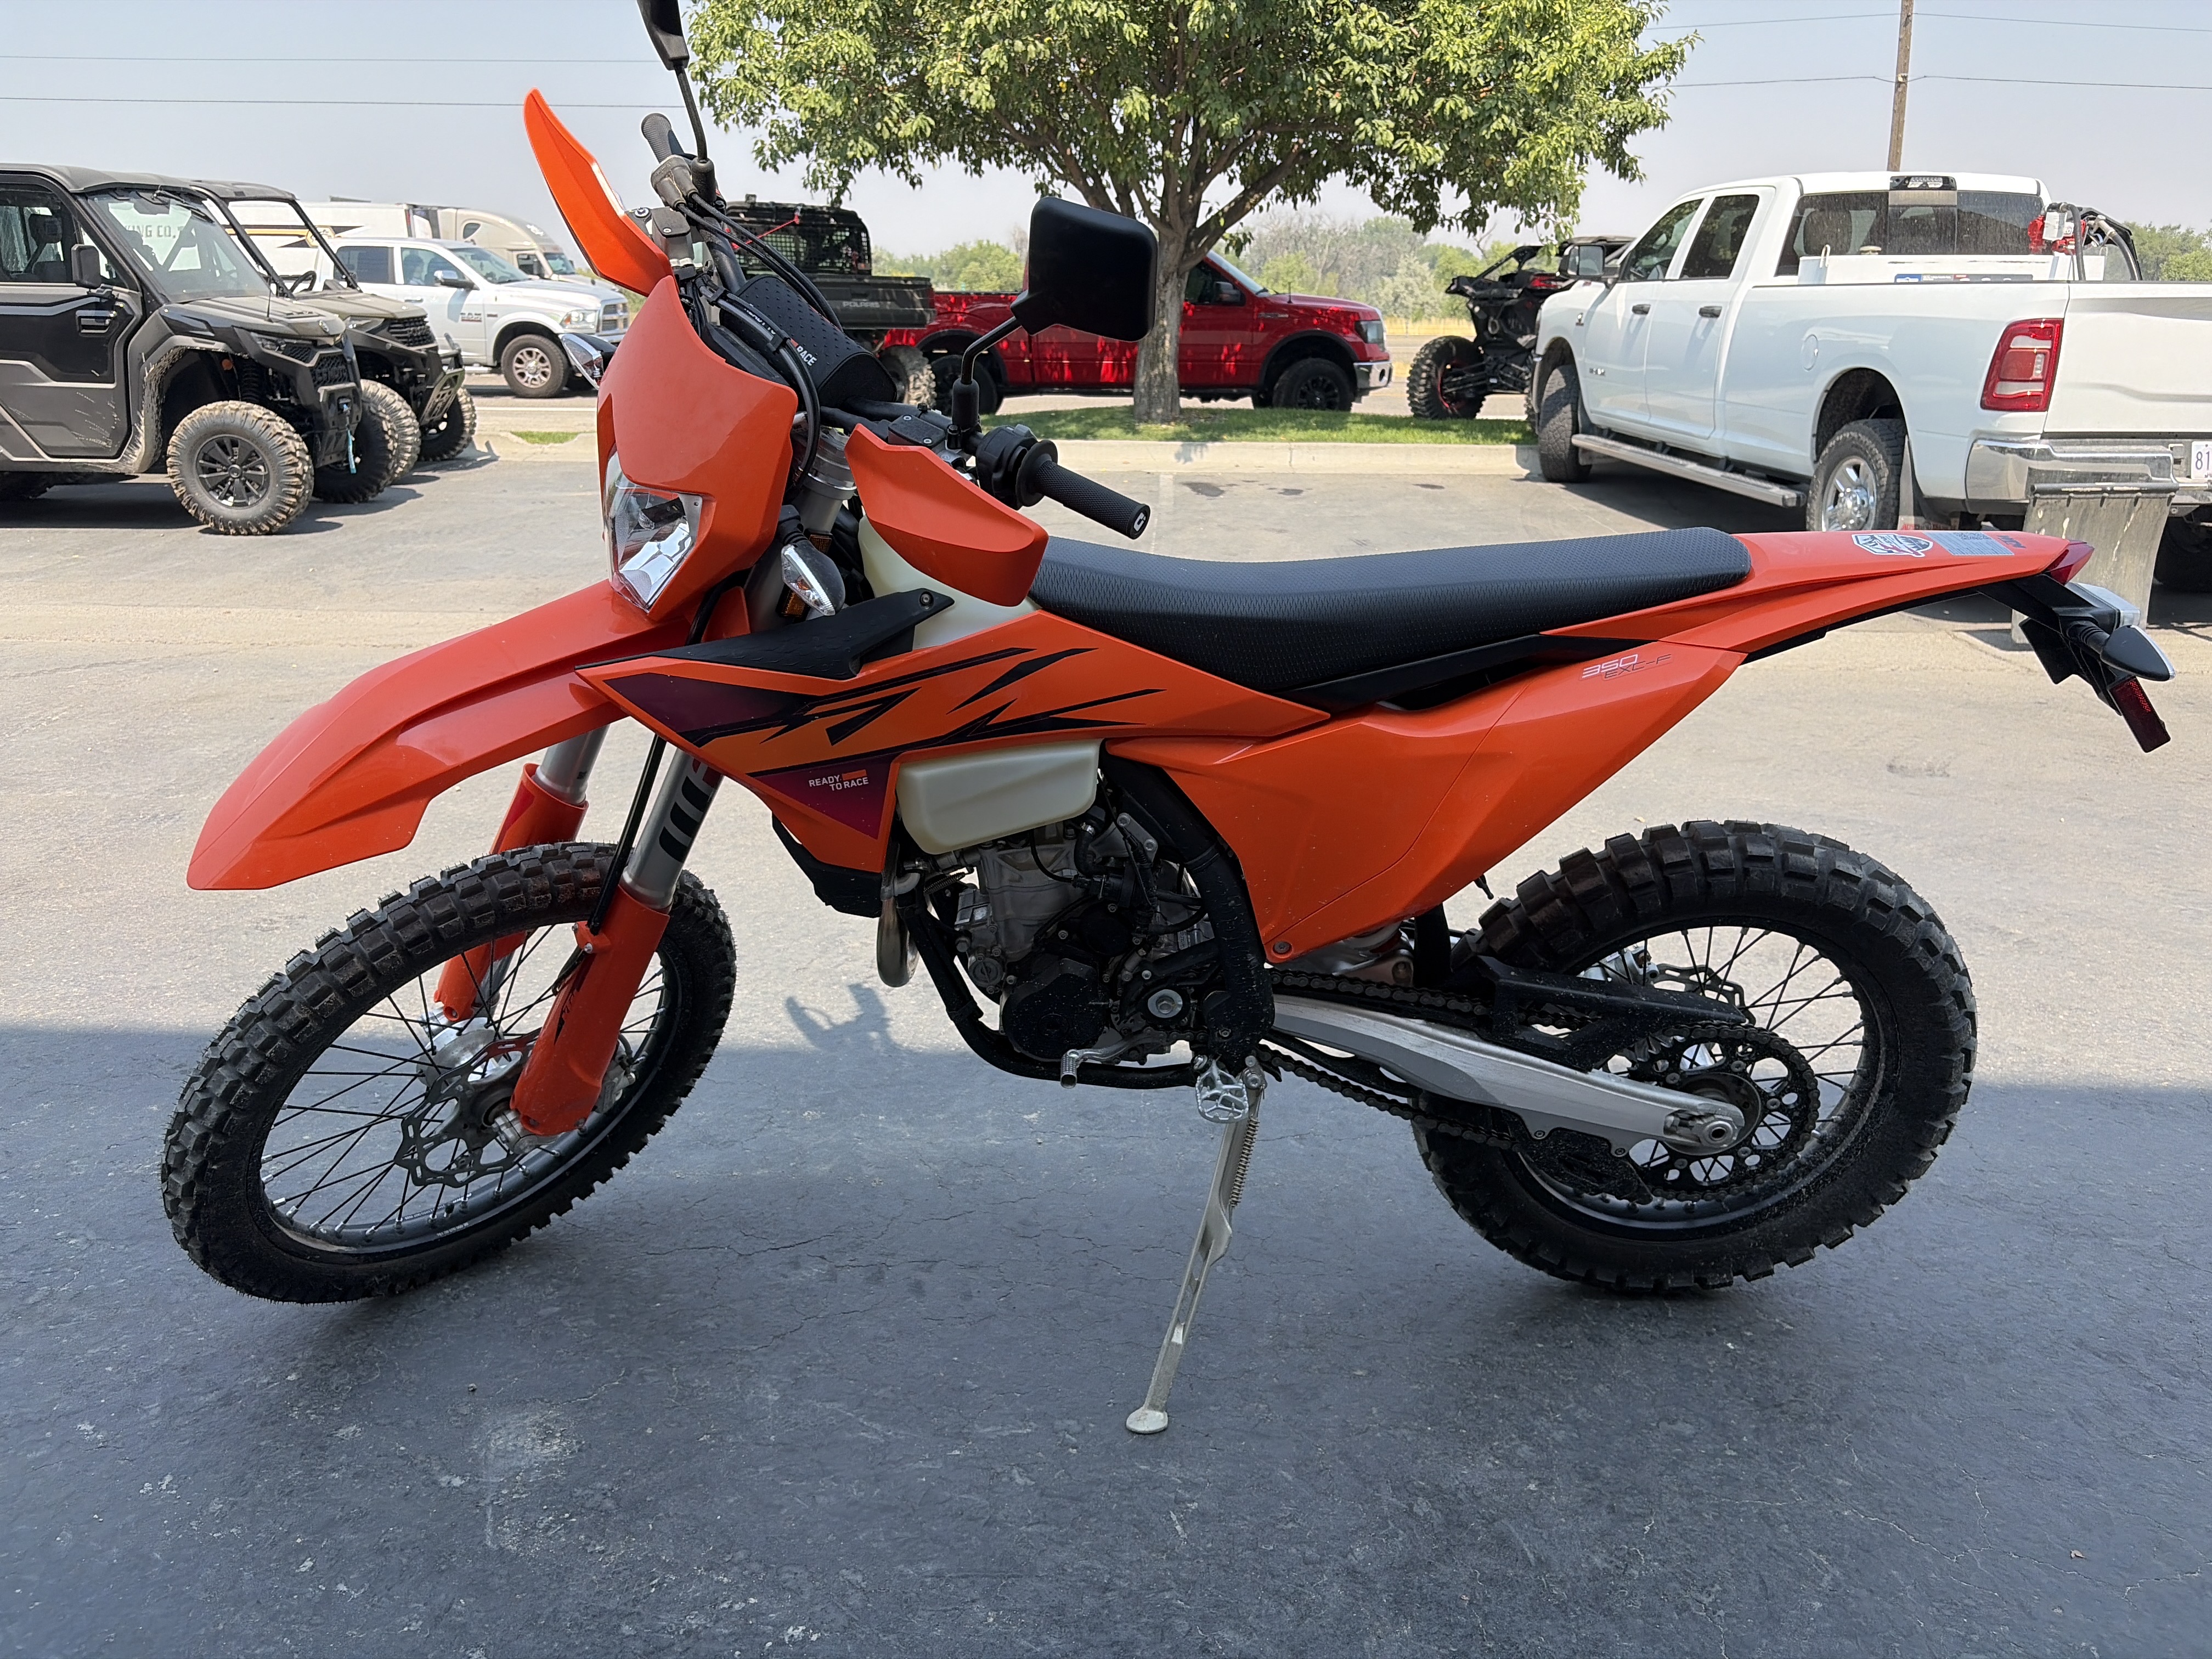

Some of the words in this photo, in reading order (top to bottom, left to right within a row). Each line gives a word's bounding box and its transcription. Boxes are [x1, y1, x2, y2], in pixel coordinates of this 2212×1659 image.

[157, 225, 176, 238] CO.
[797, 346, 817, 366] RACE
[1582, 654, 1638, 679] 350
[1605, 654, 1672, 679] EXC-F
[829, 783, 843, 791] TO
[843, 777, 869, 789] RACE
